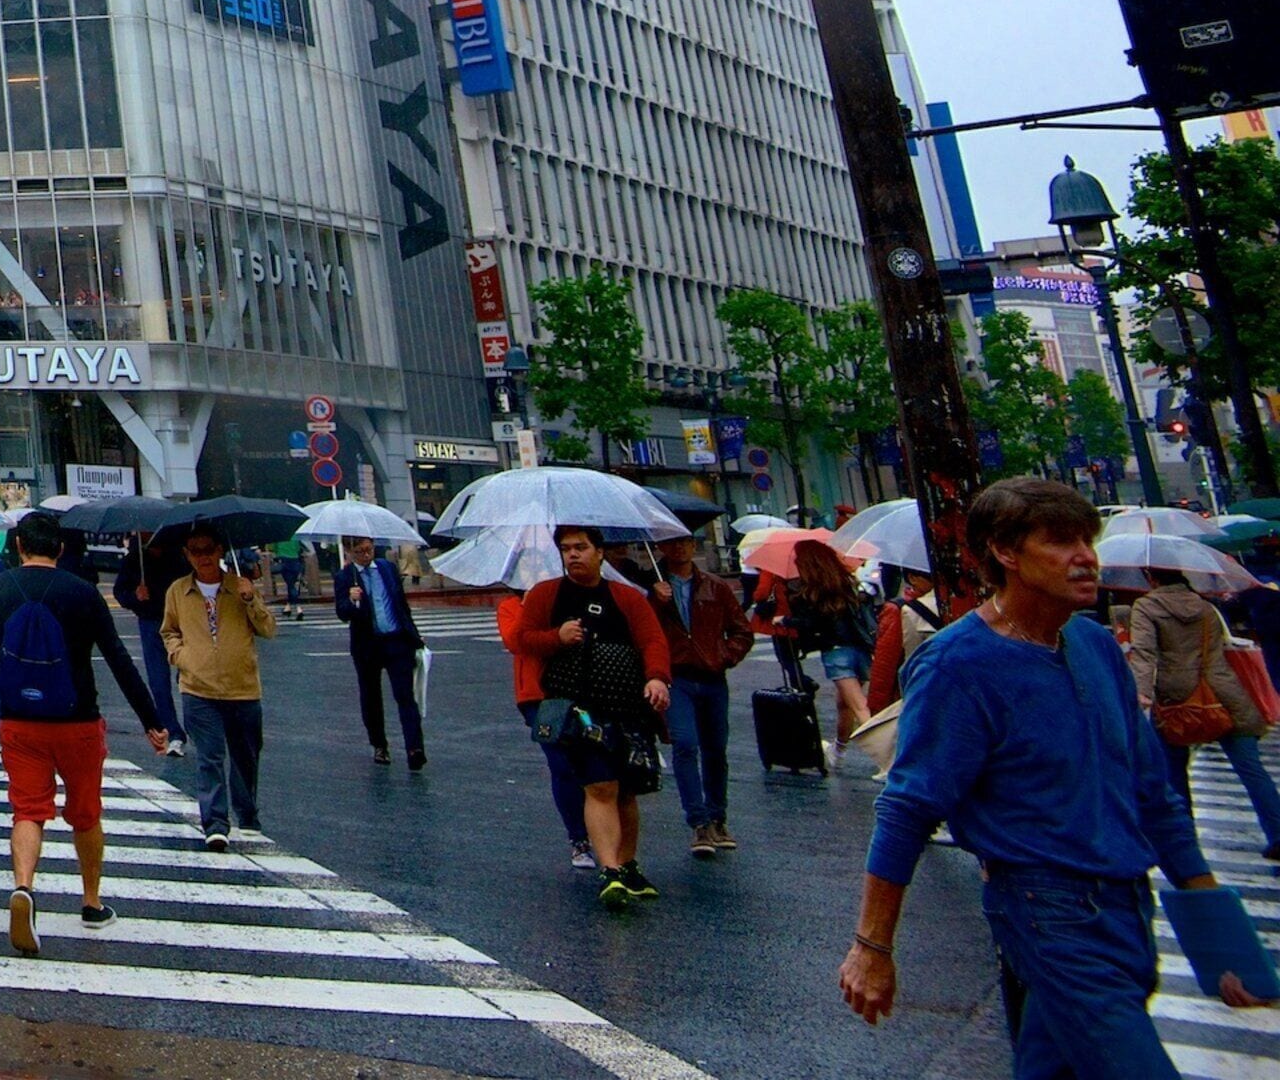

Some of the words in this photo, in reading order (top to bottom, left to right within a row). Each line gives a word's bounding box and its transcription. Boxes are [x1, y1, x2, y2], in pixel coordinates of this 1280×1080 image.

[231, 246, 353, 298] TSUTAYA
[485, 339, 506, 360] 本
[415, 441, 460, 460] TSUTAYA
